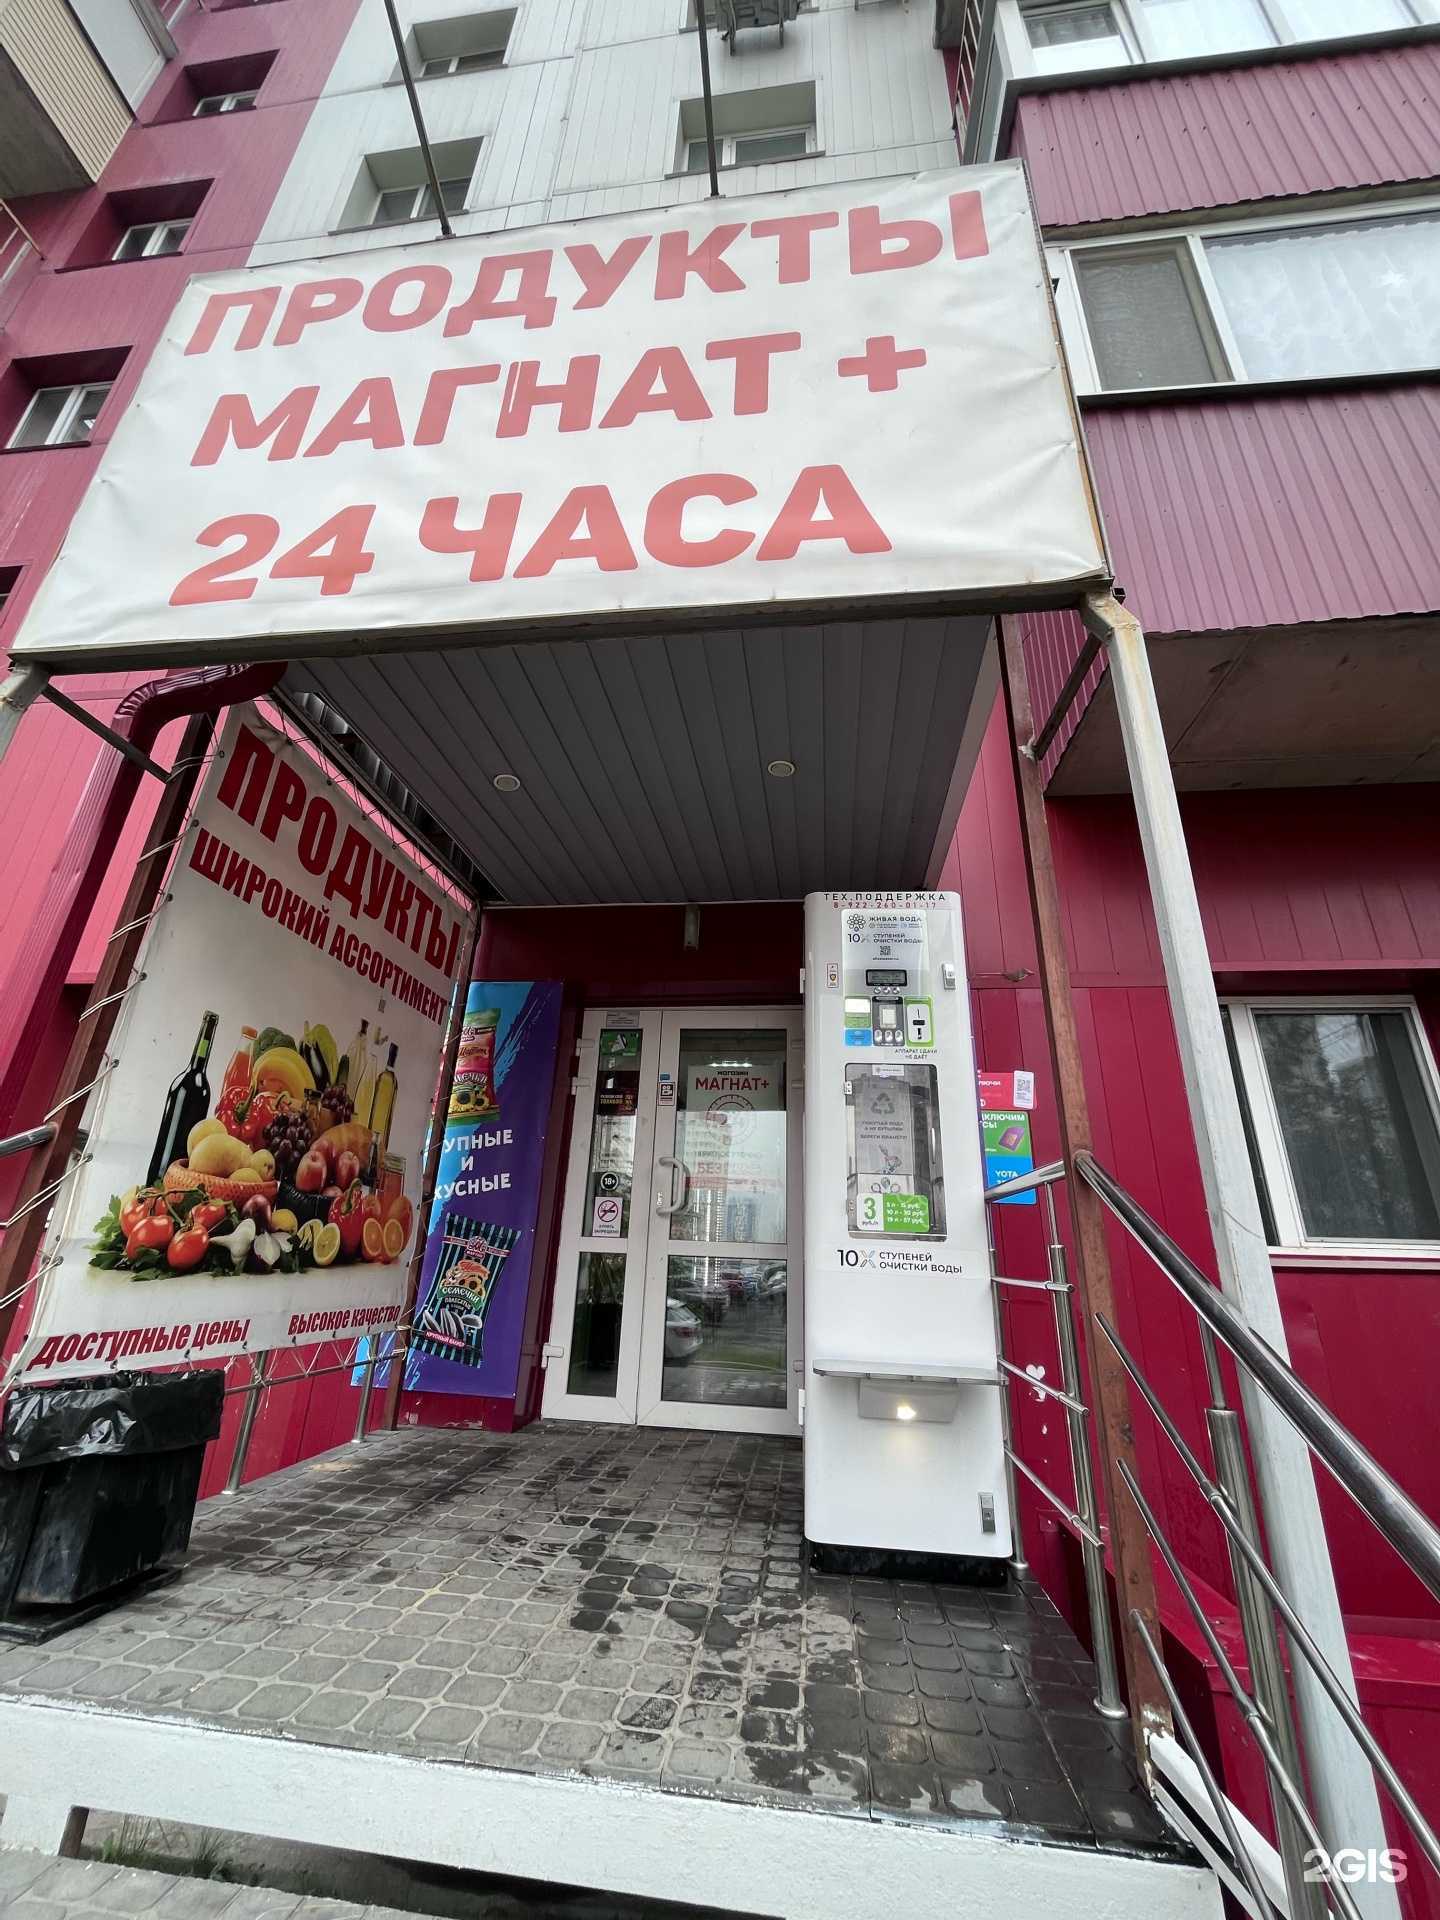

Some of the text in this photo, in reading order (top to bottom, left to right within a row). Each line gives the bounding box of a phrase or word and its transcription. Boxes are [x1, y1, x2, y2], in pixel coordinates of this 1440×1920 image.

[184, 190, 989, 356] ПРОДУКТЫ
[190, 333, 801, 466] МАГНАТ
[170, 464, 893, 606] 24 ЧАСА
[217, 723, 461, 978] ПРОДУКТЫ
[189, 828, 447, 1025] ШИРОКИЙ АССОРТИМЕНТ
[695, 1077, 770, 1091] МАГНАТ+
[604, 1177, 616, 1185] 18+
[863, 1197, 876, 1220] 3
[879, 1251, 932, 1261] СТУПЕНЕЙ
[879, 1261, 962, 1274] ОЧИСТКИ ВОДЫ
